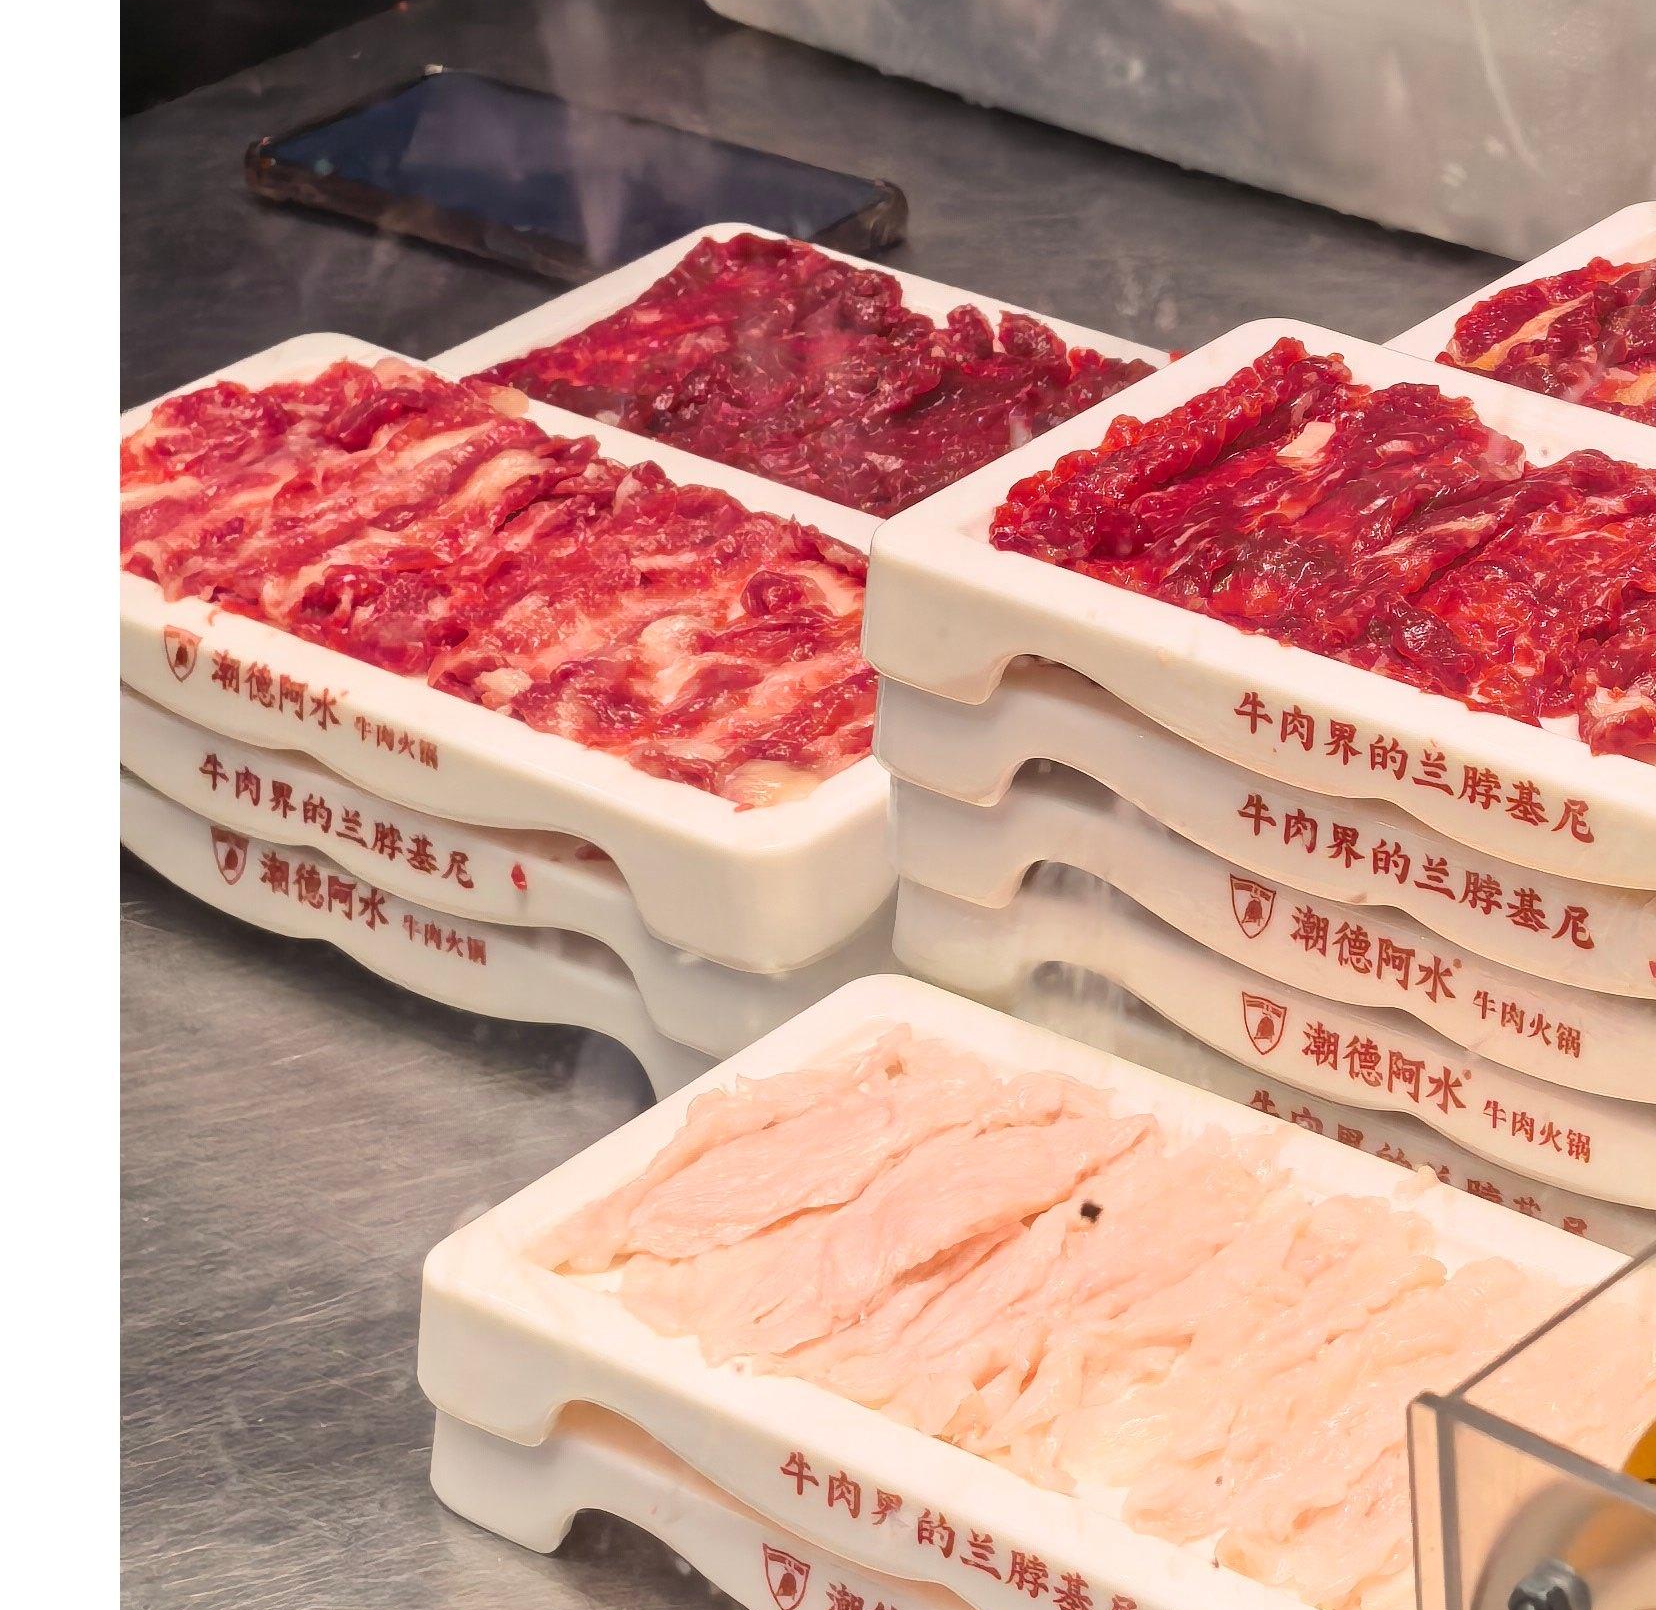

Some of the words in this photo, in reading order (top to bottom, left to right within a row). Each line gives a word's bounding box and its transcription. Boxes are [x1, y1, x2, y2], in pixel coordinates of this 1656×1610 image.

[211, 648, 340, 729] 潮德阿水
[356, 715, 440, 771] 牛肉火锅
[1235, 691, 1595, 844] 牛肉界的兰脖基尼
[198, 752, 476, 889] 牛肉界的兰脖基尼
[1237, 794, 1595, 950] 牛肉界的兰脖基尼
[259, 851, 390, 931] 潮德阿水
[403, 912, 487, 966] 牛肉火锅
[1290, 905, 1456, 1004] 潮德阿水
[1473, 990, 1582, 1059] 牛肉火锅
[1302, 1021, 1468, 1114] 潮德阿水
[1484, 1100, 1591, 1164] 牛肉火锅
